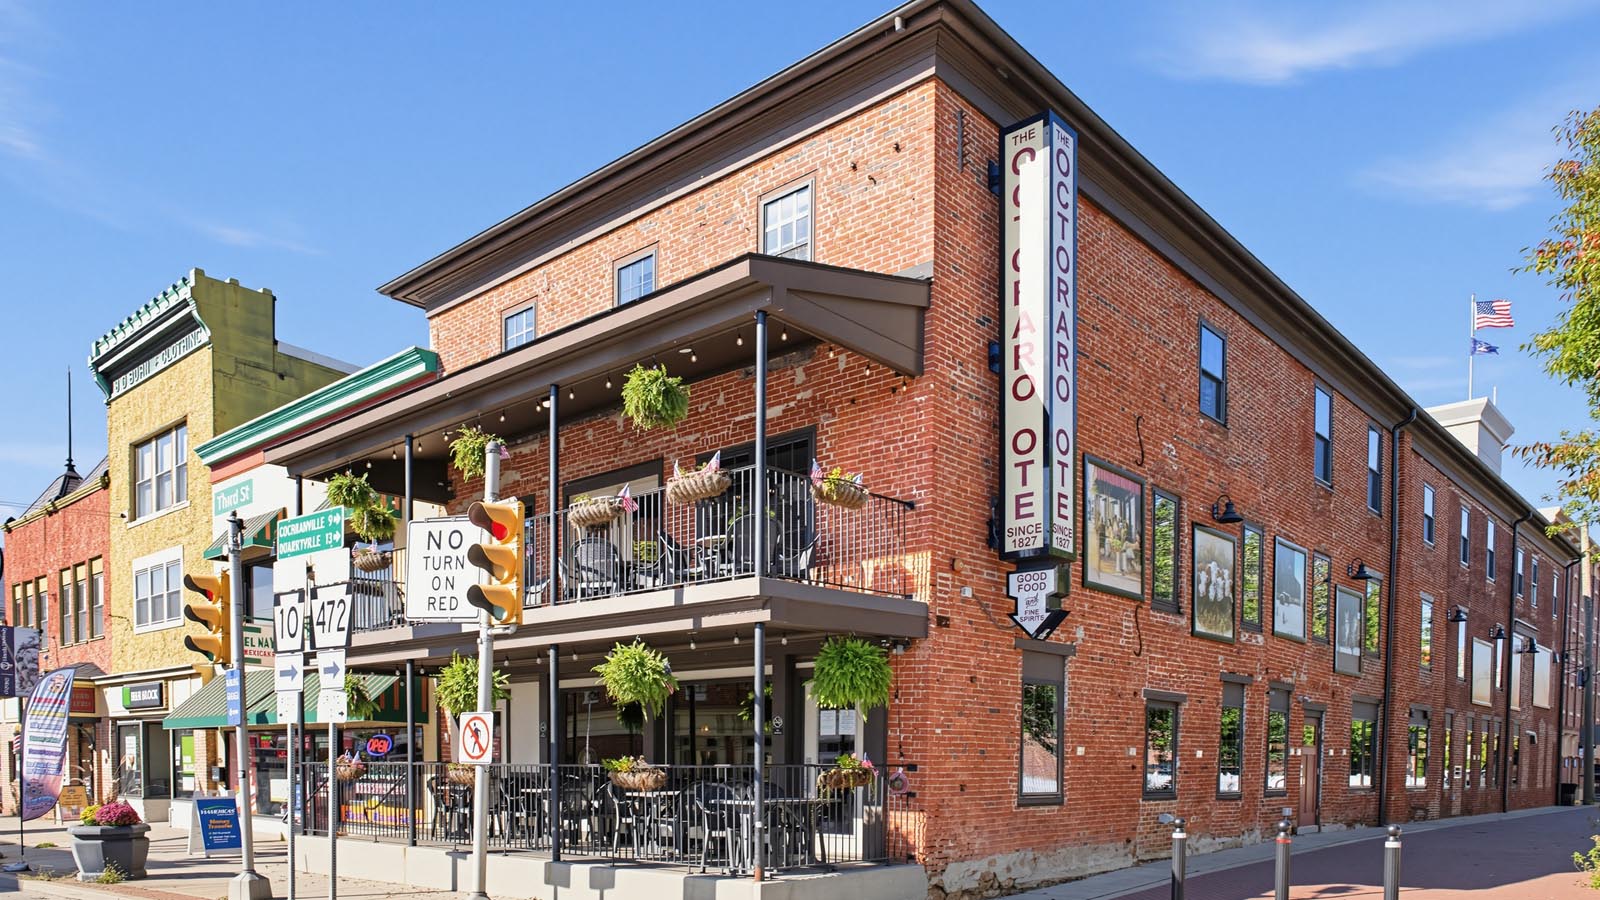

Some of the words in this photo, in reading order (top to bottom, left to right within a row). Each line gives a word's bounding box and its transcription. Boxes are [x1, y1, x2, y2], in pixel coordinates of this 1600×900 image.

[1012, 128, 1036, 146] THE
[1056, 128, 1070, 148] THE
[1055, 147, 1071, 403] OCTORARO
[217, 491, 238, 510] Third
[240, 485, 250, 502] St
[328, 515, 333, 527] 9
[1006, 522, 1042, 538] SINCE
[1052, 522, 1073, 538] SINCE
[325, 532, 333, 545] 13
[427, 529, 463, 551] NO
[1012, 535, 1038, 549] 1827
[1055, 536, 1070, 549] 1827
[423, 555, 465, 571] TURN
[431, 576, 455, 591] ON
[1016, 571, 1048, 583] GOOD
[1017, 581, 1047, 593] FOOD
[427, 596, 459, 611] RED
[1025, 593, 1039, 609] and
[316, 598, 346, 634] 472
[1019, 614, 1045, 623] SPIRITS
[1024, 608, 1040, 616] FINE
[279, 606, 299, 639] 10
[244, 636, 256, 647] EL
[142, 689, 159, 701] BLOCK
[367, 737, 389, 754] OPEN
